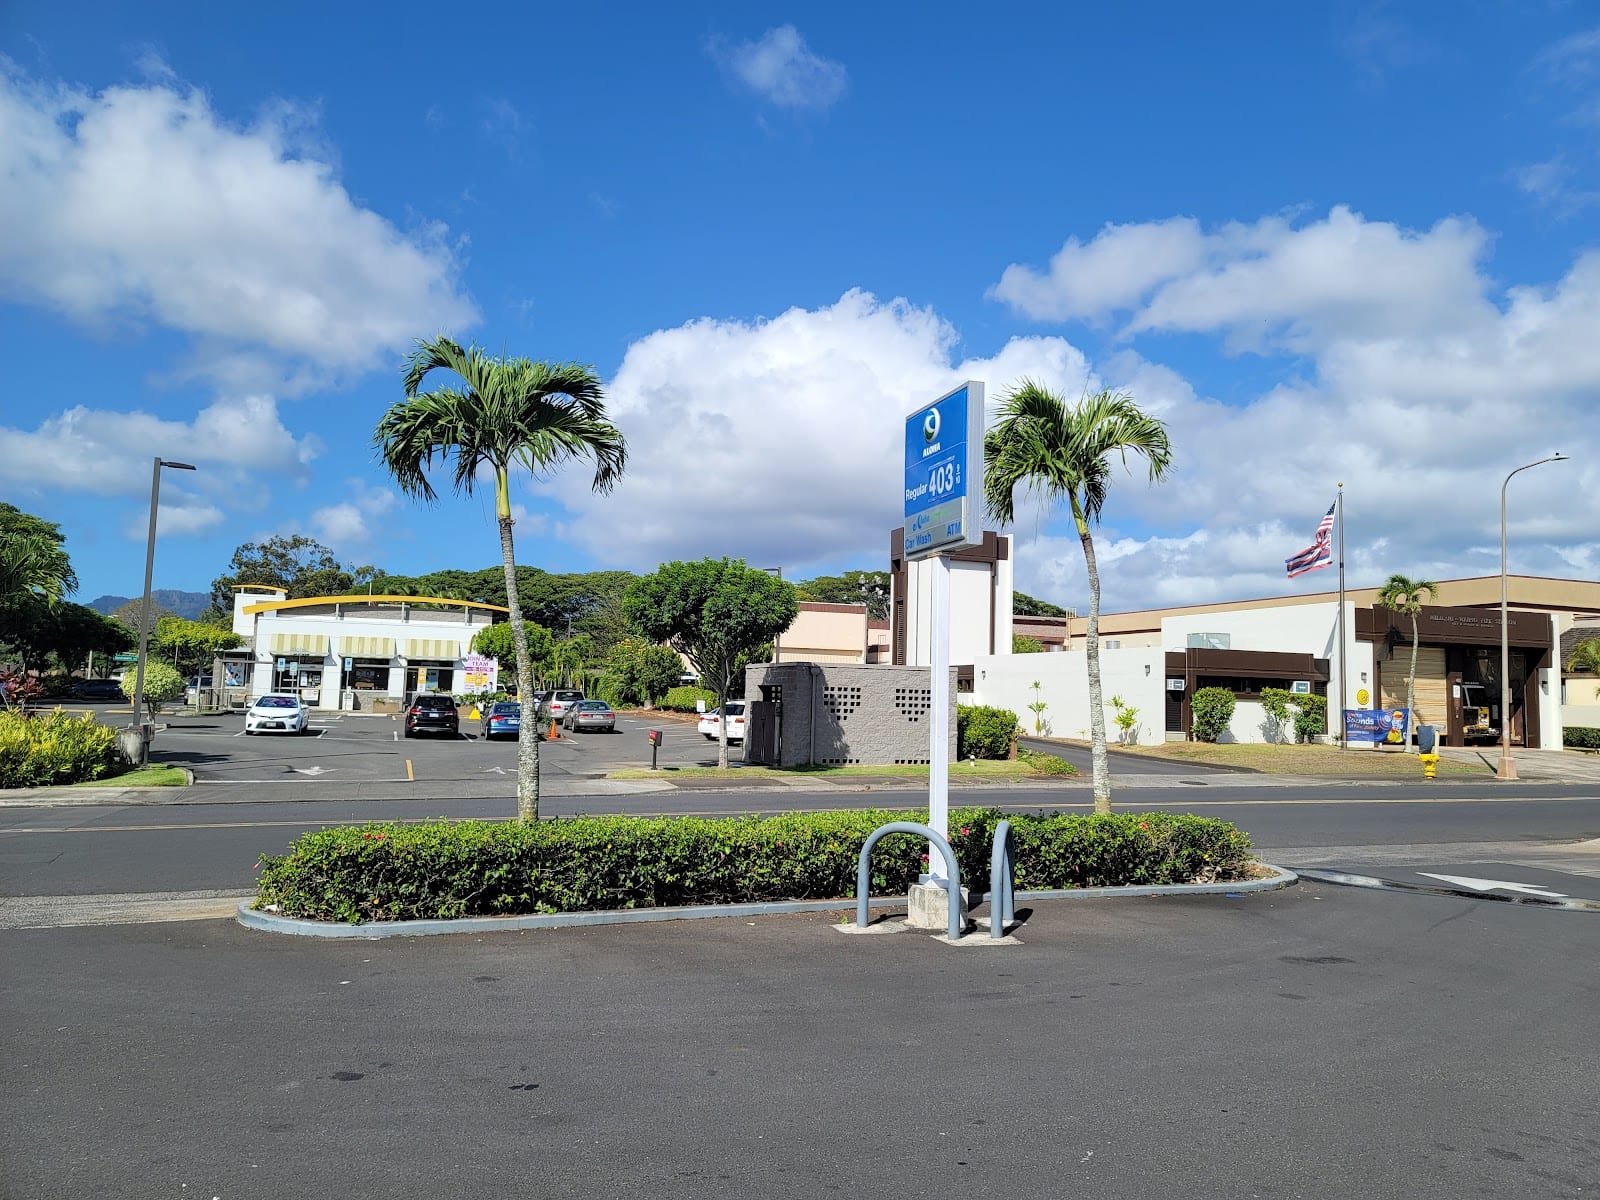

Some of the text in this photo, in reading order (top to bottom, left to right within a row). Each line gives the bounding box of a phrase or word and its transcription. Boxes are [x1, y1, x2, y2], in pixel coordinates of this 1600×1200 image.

[922, 442, 941, 458] ALOHA
[905, 483, 928, 501] Regular
[929, 462, 954, 497] 403
[946, 521, 961, 537] ATM
[905, 531, 932, 550] Car Wash
[1346, 716, 1375, 725] Sounds
